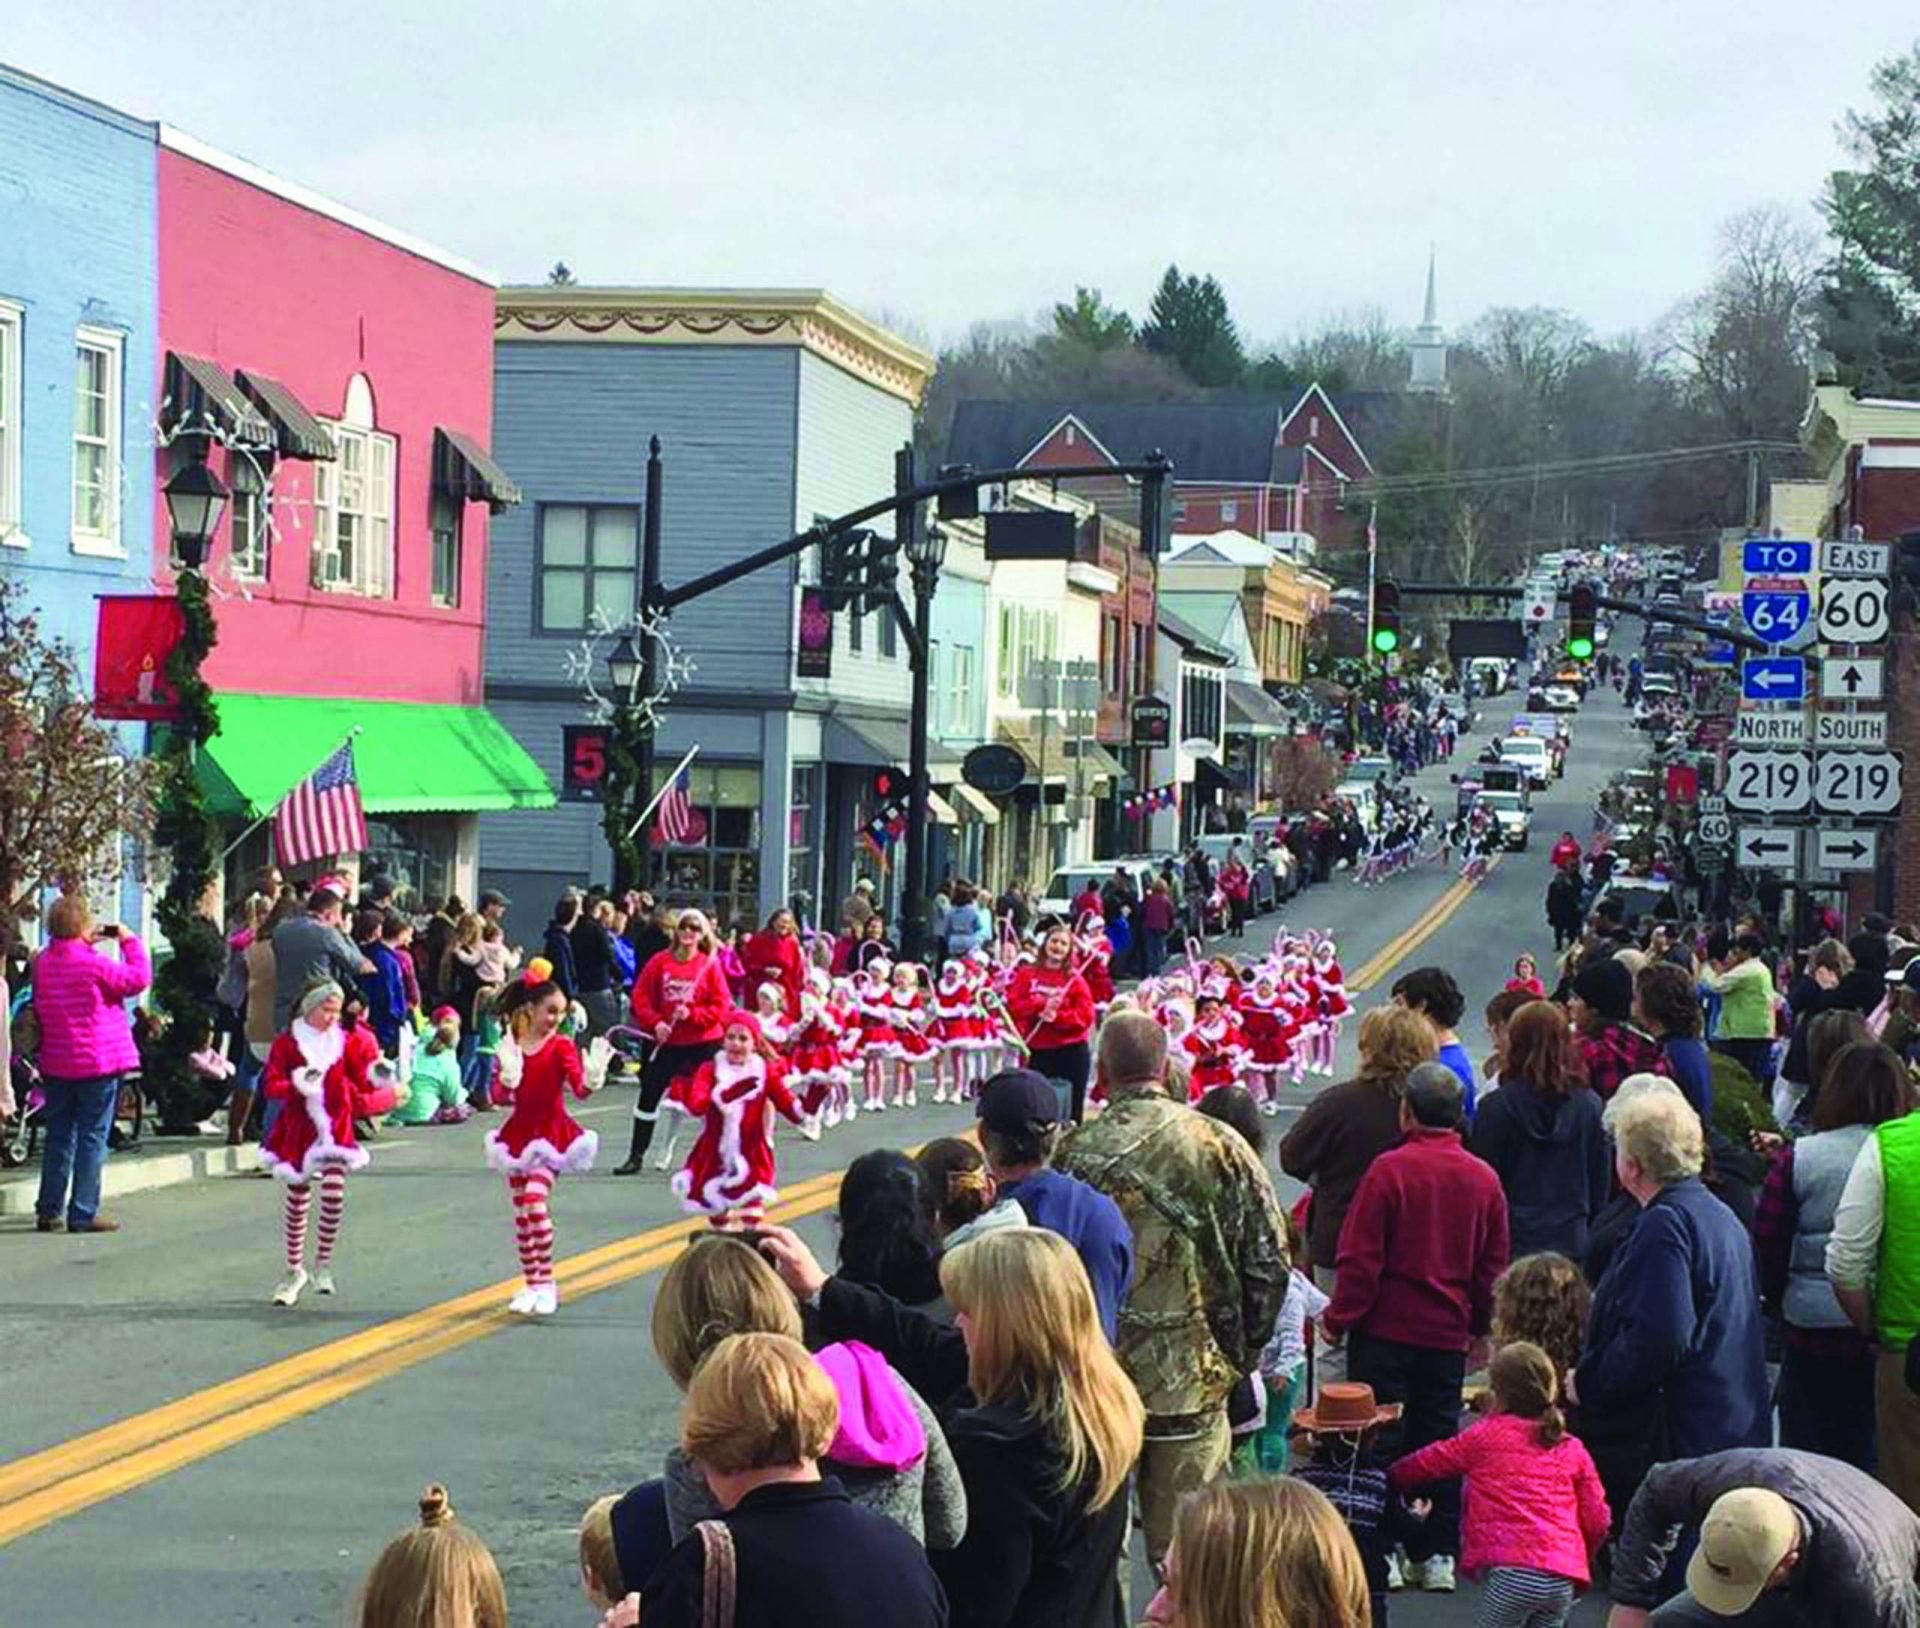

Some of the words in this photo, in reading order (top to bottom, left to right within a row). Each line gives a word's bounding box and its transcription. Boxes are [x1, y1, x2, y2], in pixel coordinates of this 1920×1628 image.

[1759, 547, 1797, 567] TO
[1829, 545, 1881, 570] EAST
[1752, 601, 1800, 631] 64
[1825, 591, 1880, 628] 60
[1739, 717, 1803, 739] NORTH
[1820, 717, 1882, 739] SOUTH
[575, 736, 605, 783] 5
[1738, 762, 1800, 799] 219
[1828, 763, 1890, 801] 219
[1702, 819, 1728, 839] 60
